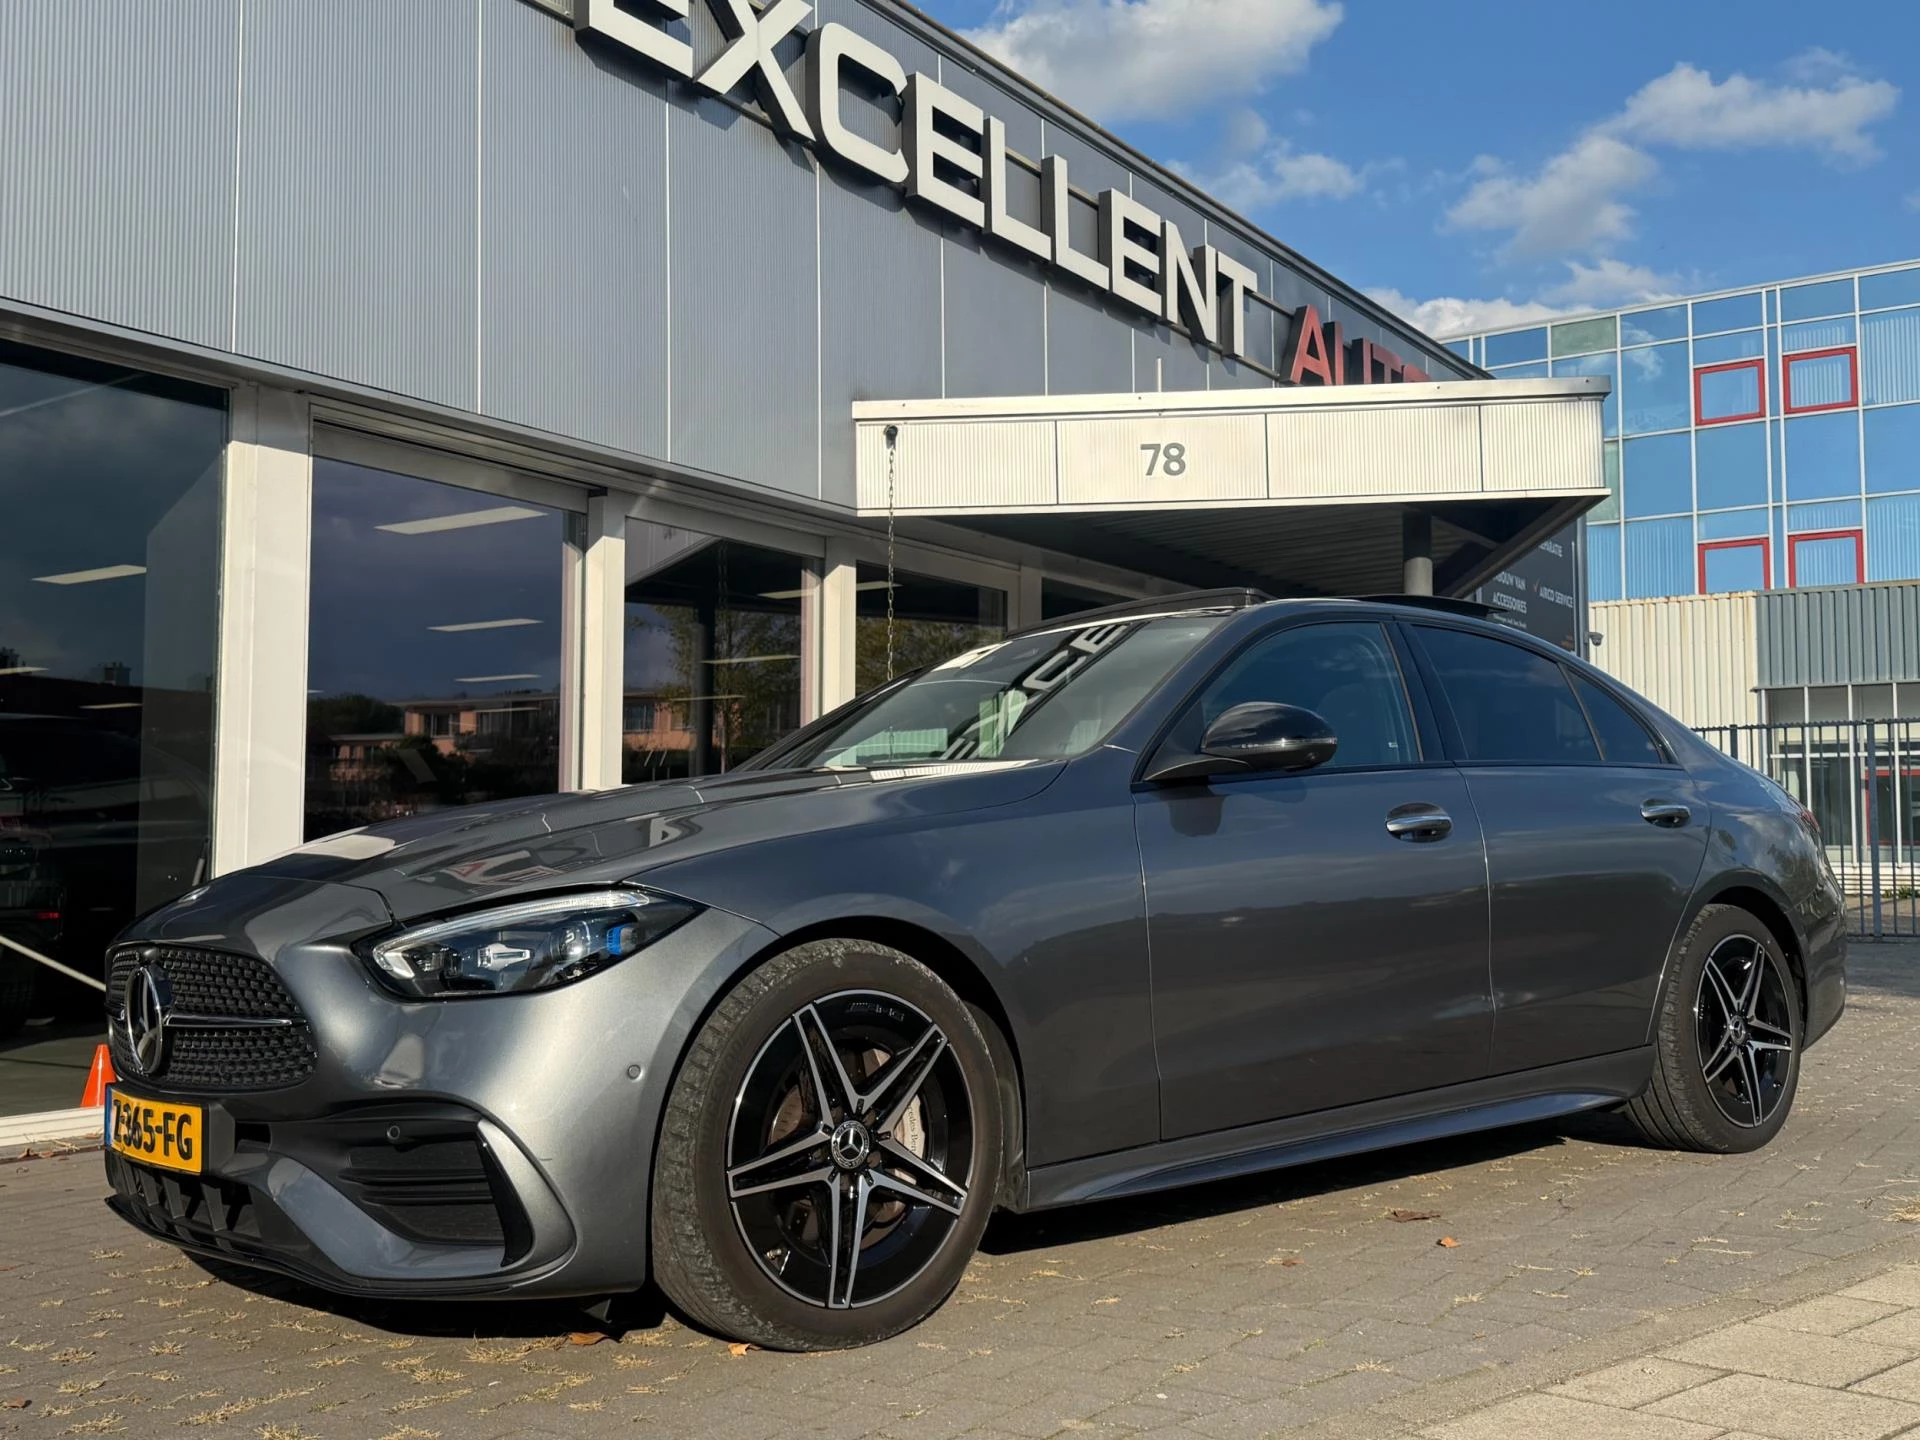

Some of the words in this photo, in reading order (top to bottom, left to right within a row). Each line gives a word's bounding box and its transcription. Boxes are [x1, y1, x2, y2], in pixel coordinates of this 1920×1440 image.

[1140, 442, 1186, 476] 78
[1540, 586, 1555, 602] AIRCO
[1555, 591, 1574, 608] SERVICE
